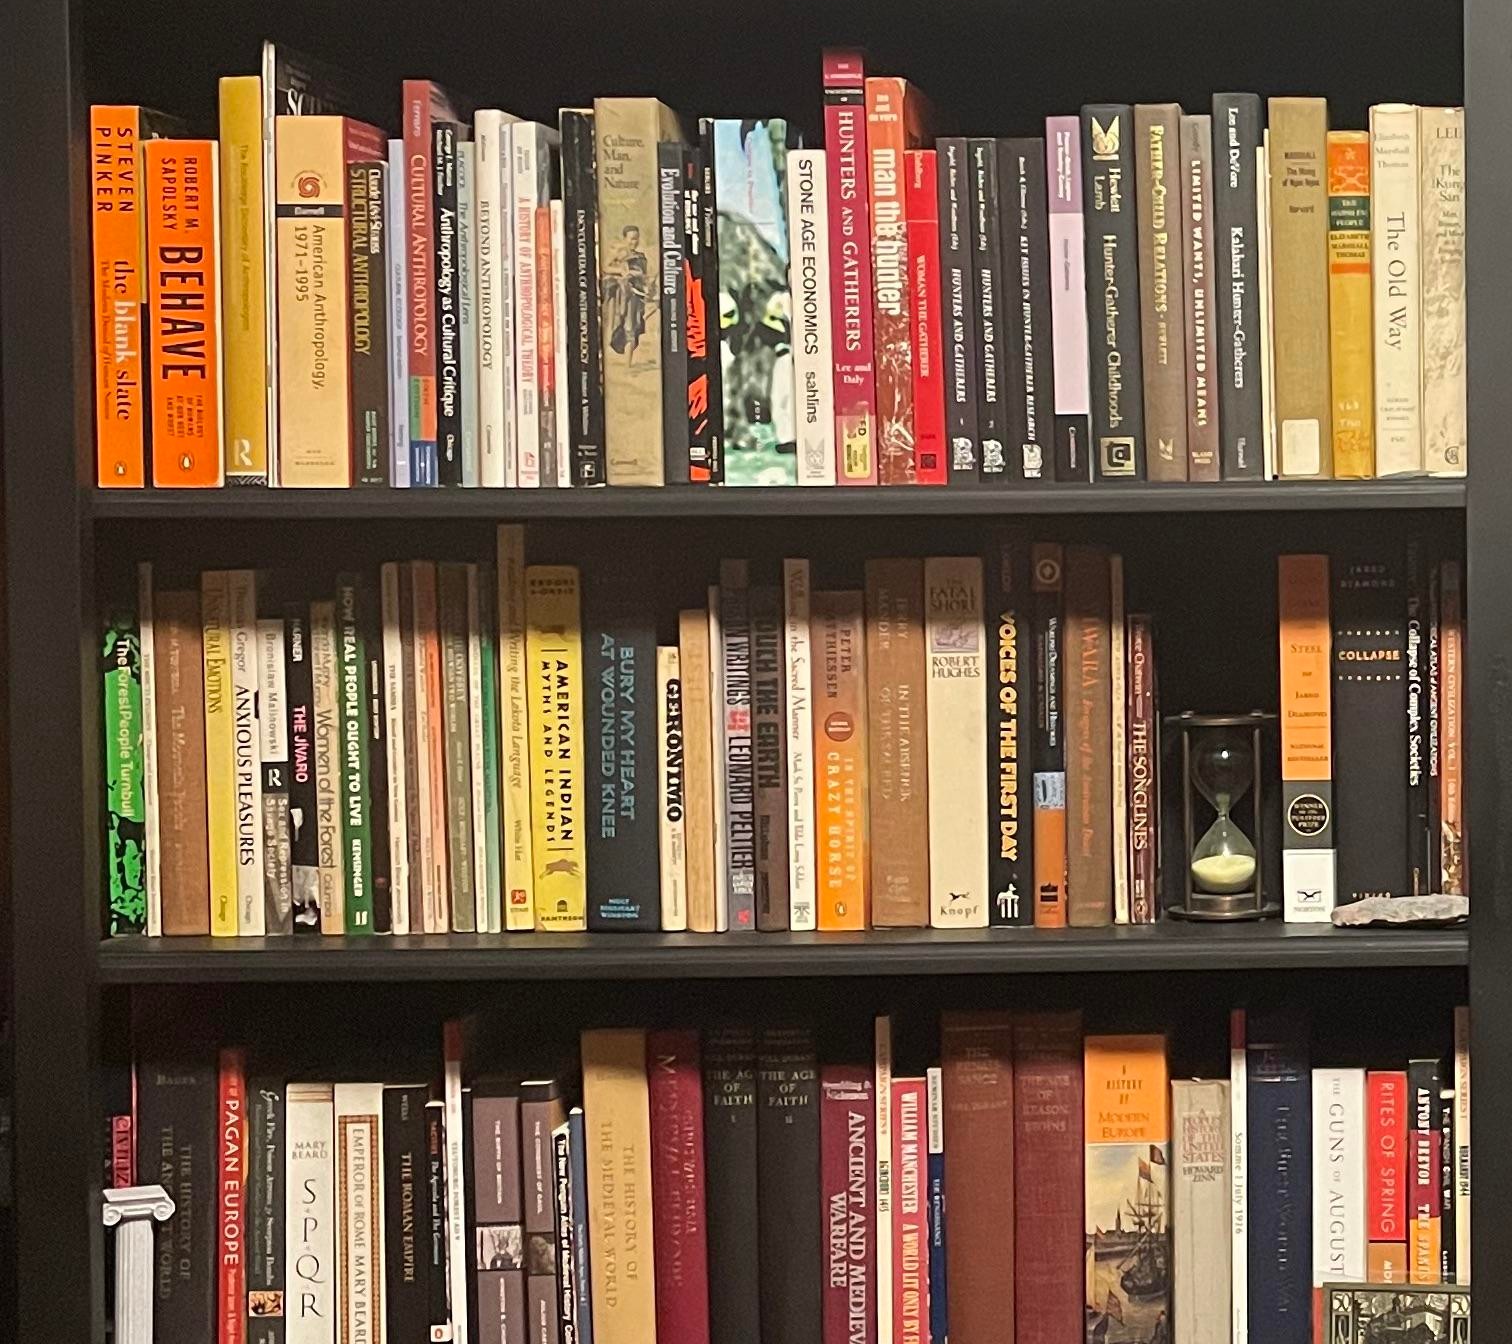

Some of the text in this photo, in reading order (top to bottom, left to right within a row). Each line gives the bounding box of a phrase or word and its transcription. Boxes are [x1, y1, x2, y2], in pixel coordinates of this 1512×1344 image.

[96, 127, 112, 212] PINKER
[117, 128, 133, 212] STEVEN
[161, 158, 177, 231] SAPOLSKY
[185, 157, 199, 211] ROBERT
[838, 111, 861, 351] HUNTERS AND GATHERERS
[115, 260, 136, 420] the blank slate
[159, 246, 206, 380] BEHAVE
[799, 159, 820, 423] STONE AGE ECONOMICS sahlins
[1386, 212, 1408, 350] The Old Way
[236, 685, 256, 866] ANXIOUS PLEASURES
[345, 666, 363, 826] PEOPLE OUGHT TO LIVE
[601, 633, 616, 838] AT WOUNDED KNEE
[620, 647, 635, 819] BURY MY HEART
[666, 678, 683, 822] GERONIMO
[1132, 722, 1149, 849] THE SONGLINES
[225, 1100, 242, 1265] PAGAN EUROPE
[848, 1111, 866, 1209] ANCIENT
[1329, 1103, 1344, 1274] GUNS AUGUST
[1380, 1082, 1396, 1232] RITES OF SPRING
[831, 1193, 846, 1287] WARFARE
[849, 1212, 866, 1260] AND
